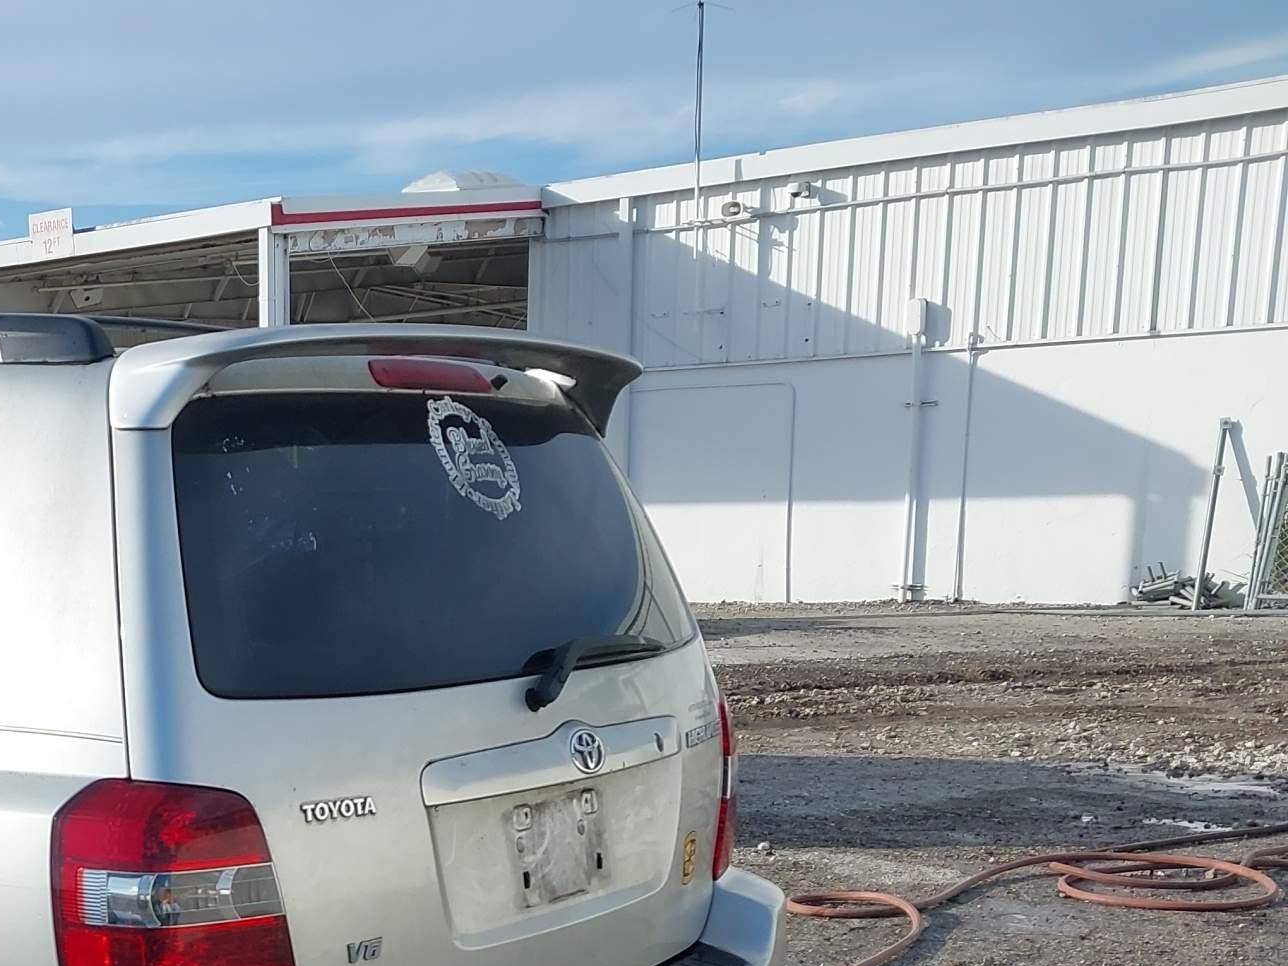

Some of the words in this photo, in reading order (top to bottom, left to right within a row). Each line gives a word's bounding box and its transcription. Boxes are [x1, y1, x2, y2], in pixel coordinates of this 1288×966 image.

[32, 218, 69, 233] CLEARANCE
[43, 238, 53, 256] 12
[300, 796, 376, 823] TOYOTA
[346, 936, 383, 964] V6
